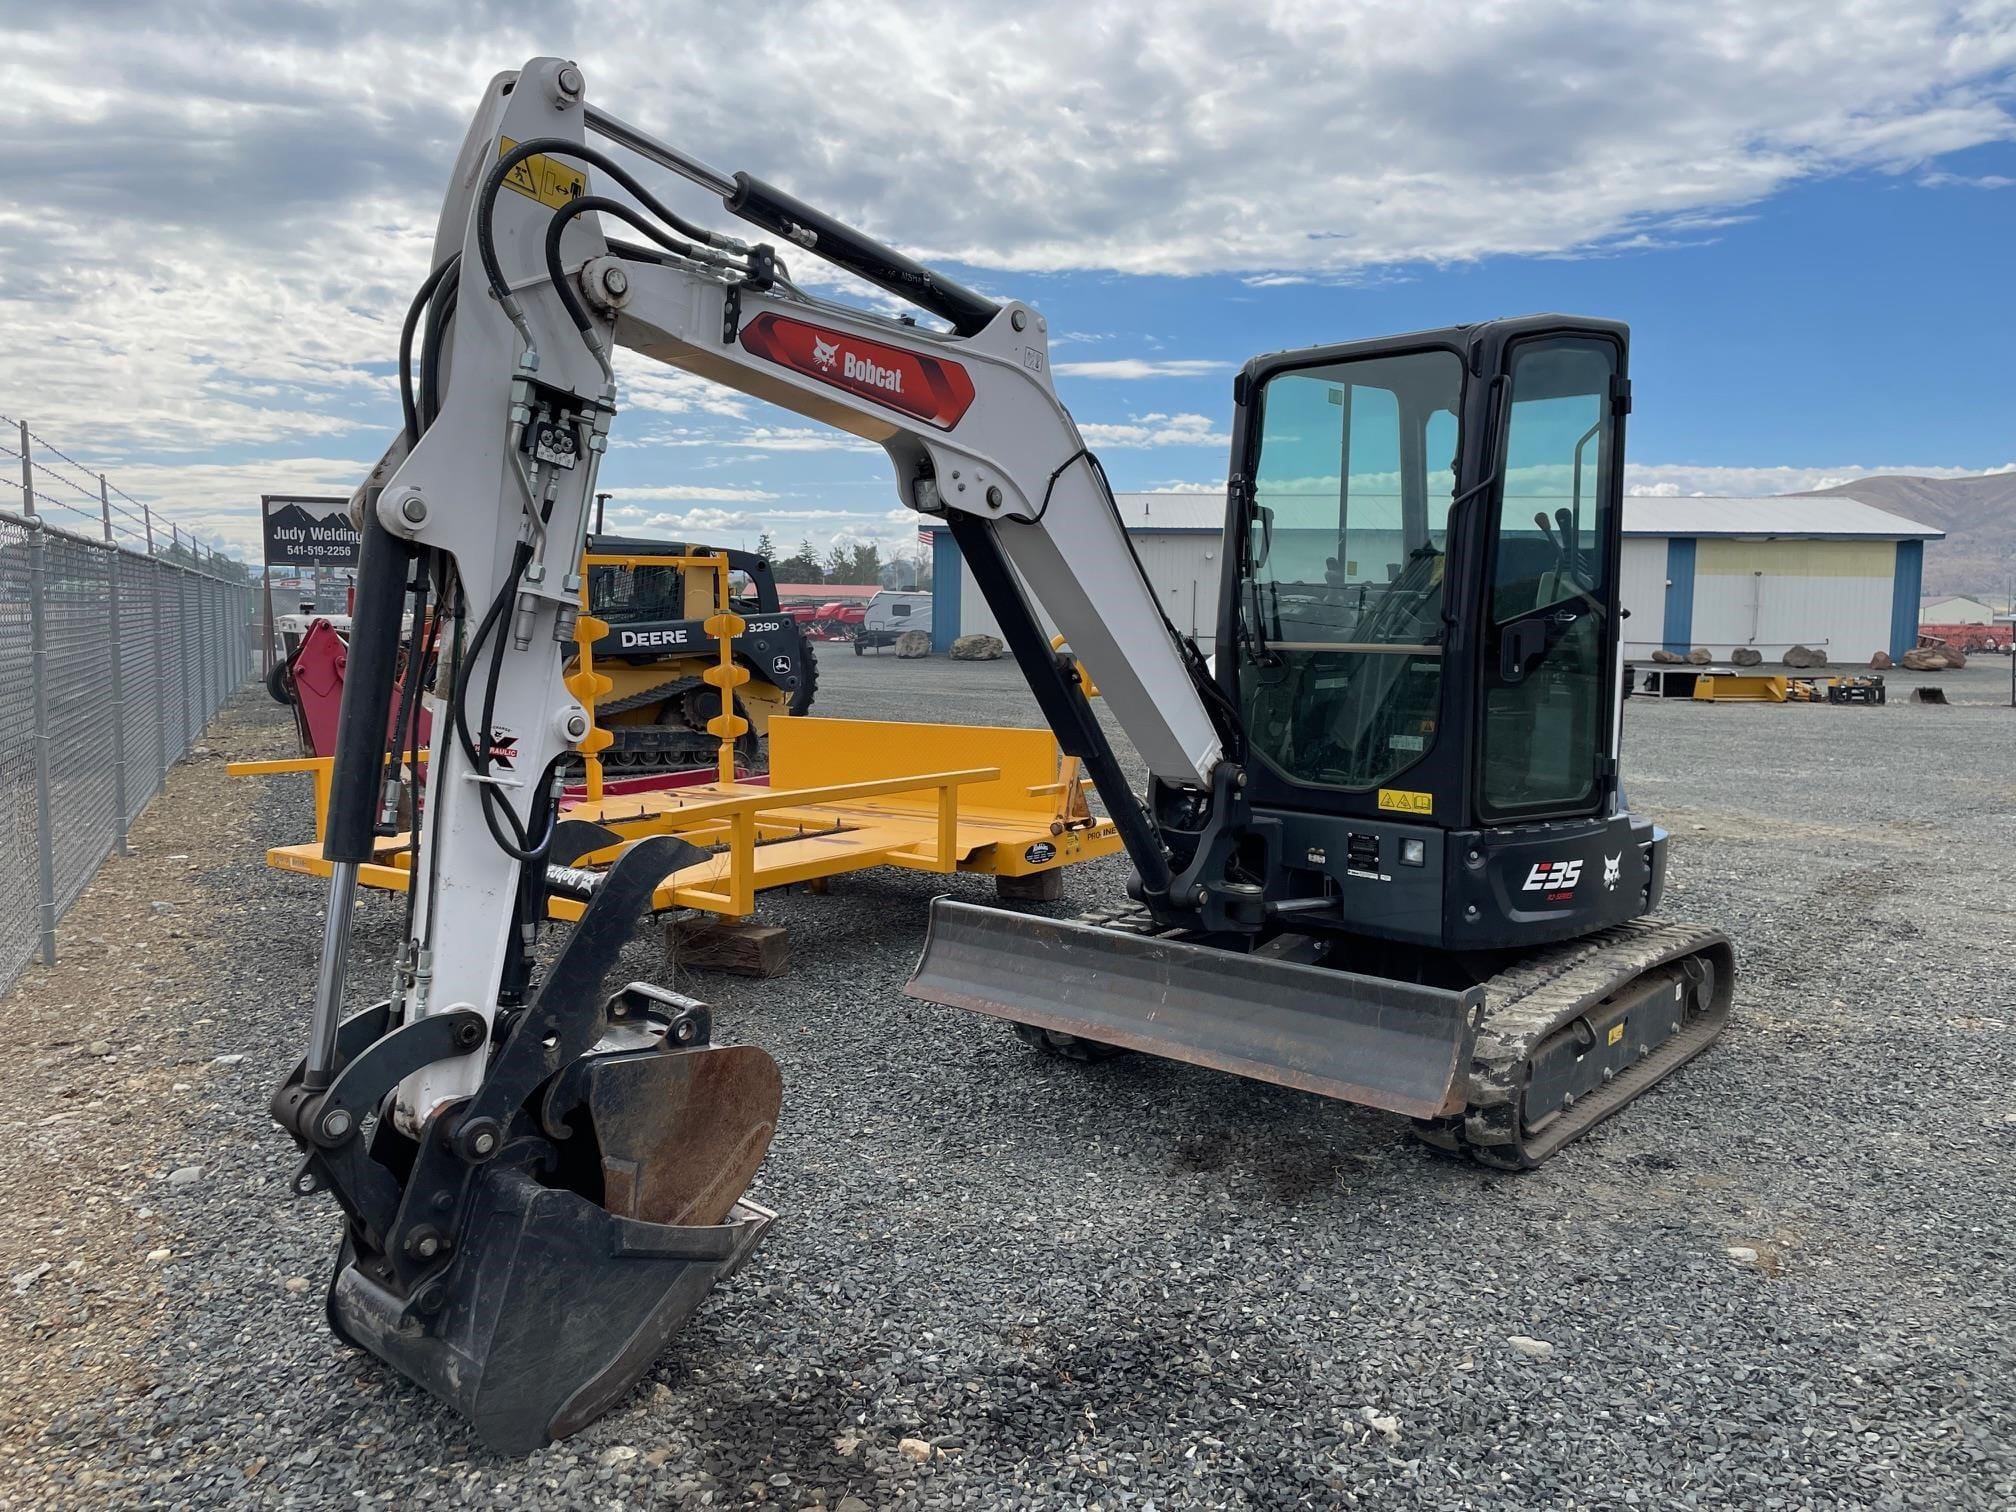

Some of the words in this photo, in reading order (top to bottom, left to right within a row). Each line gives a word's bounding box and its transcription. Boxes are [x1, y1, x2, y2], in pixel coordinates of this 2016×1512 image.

[843, 351, 902, 393] Bobcat
[273, 526, 306, 543] Judy
[310, 527, 362, 545] Welding
[287, 545, 351, 556] 541-519-2256
[748, 622, 780, 632] 329D
[621, 629, 688, 648] DEERE
[1521, 859, 1584, 891] E35
